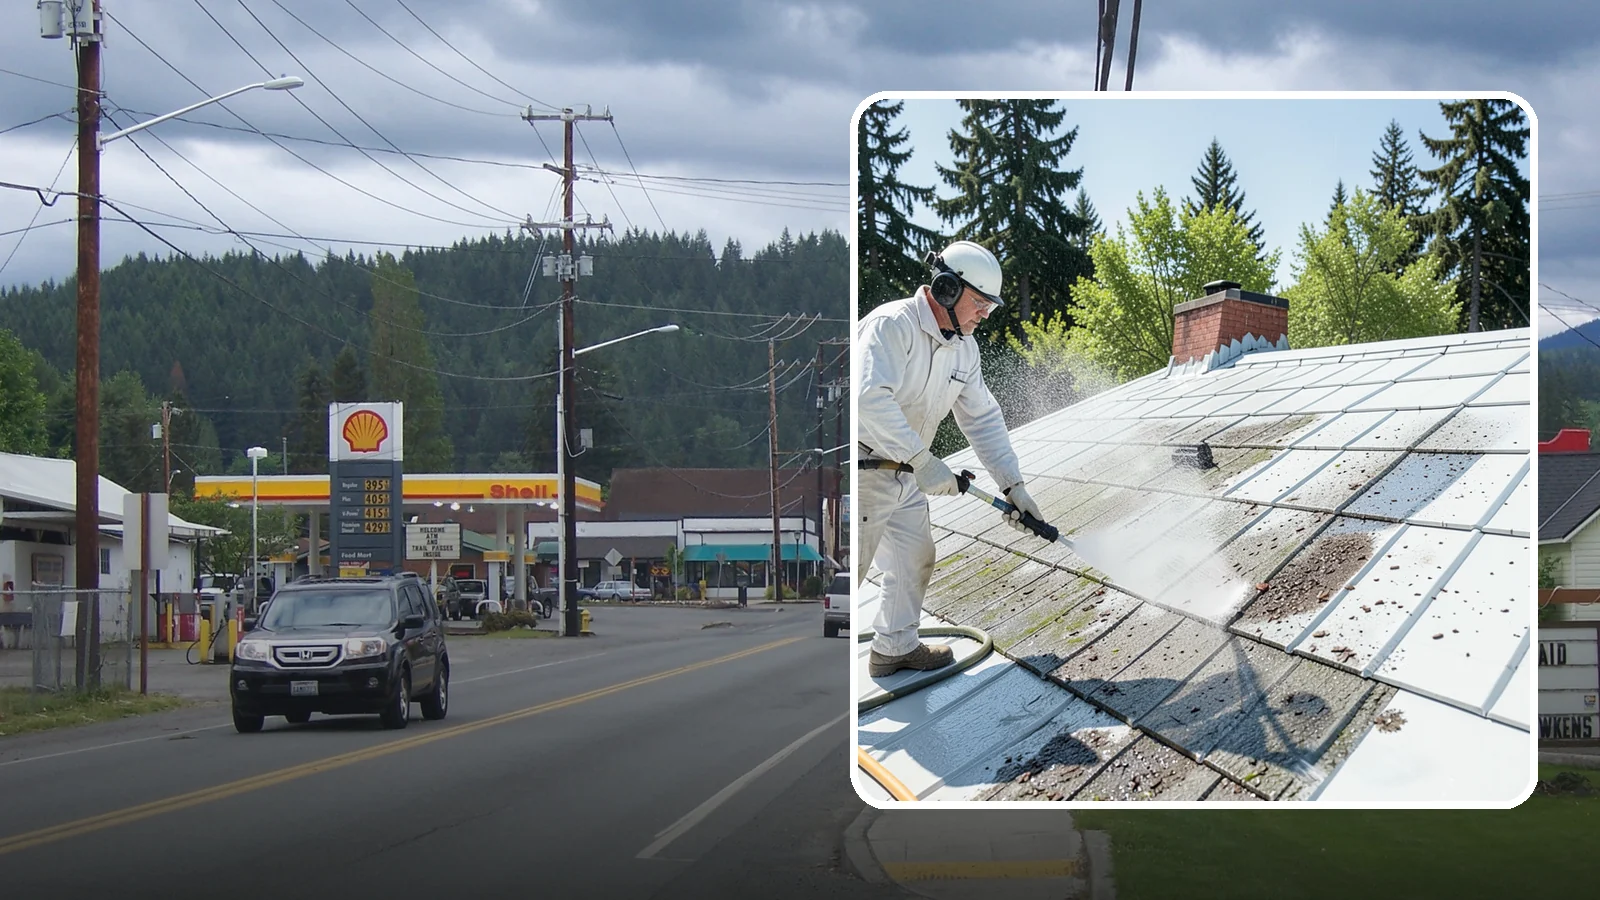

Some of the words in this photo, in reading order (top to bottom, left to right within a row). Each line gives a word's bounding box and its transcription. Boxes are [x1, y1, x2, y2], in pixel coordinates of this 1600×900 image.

[366, 480, 383, 490] 395
[490, 484, 547, 499] Shell
[366, 494, 383, 504] 405
[366, 508, 383, 518] 415
[366, 522, 383, 532] 429
